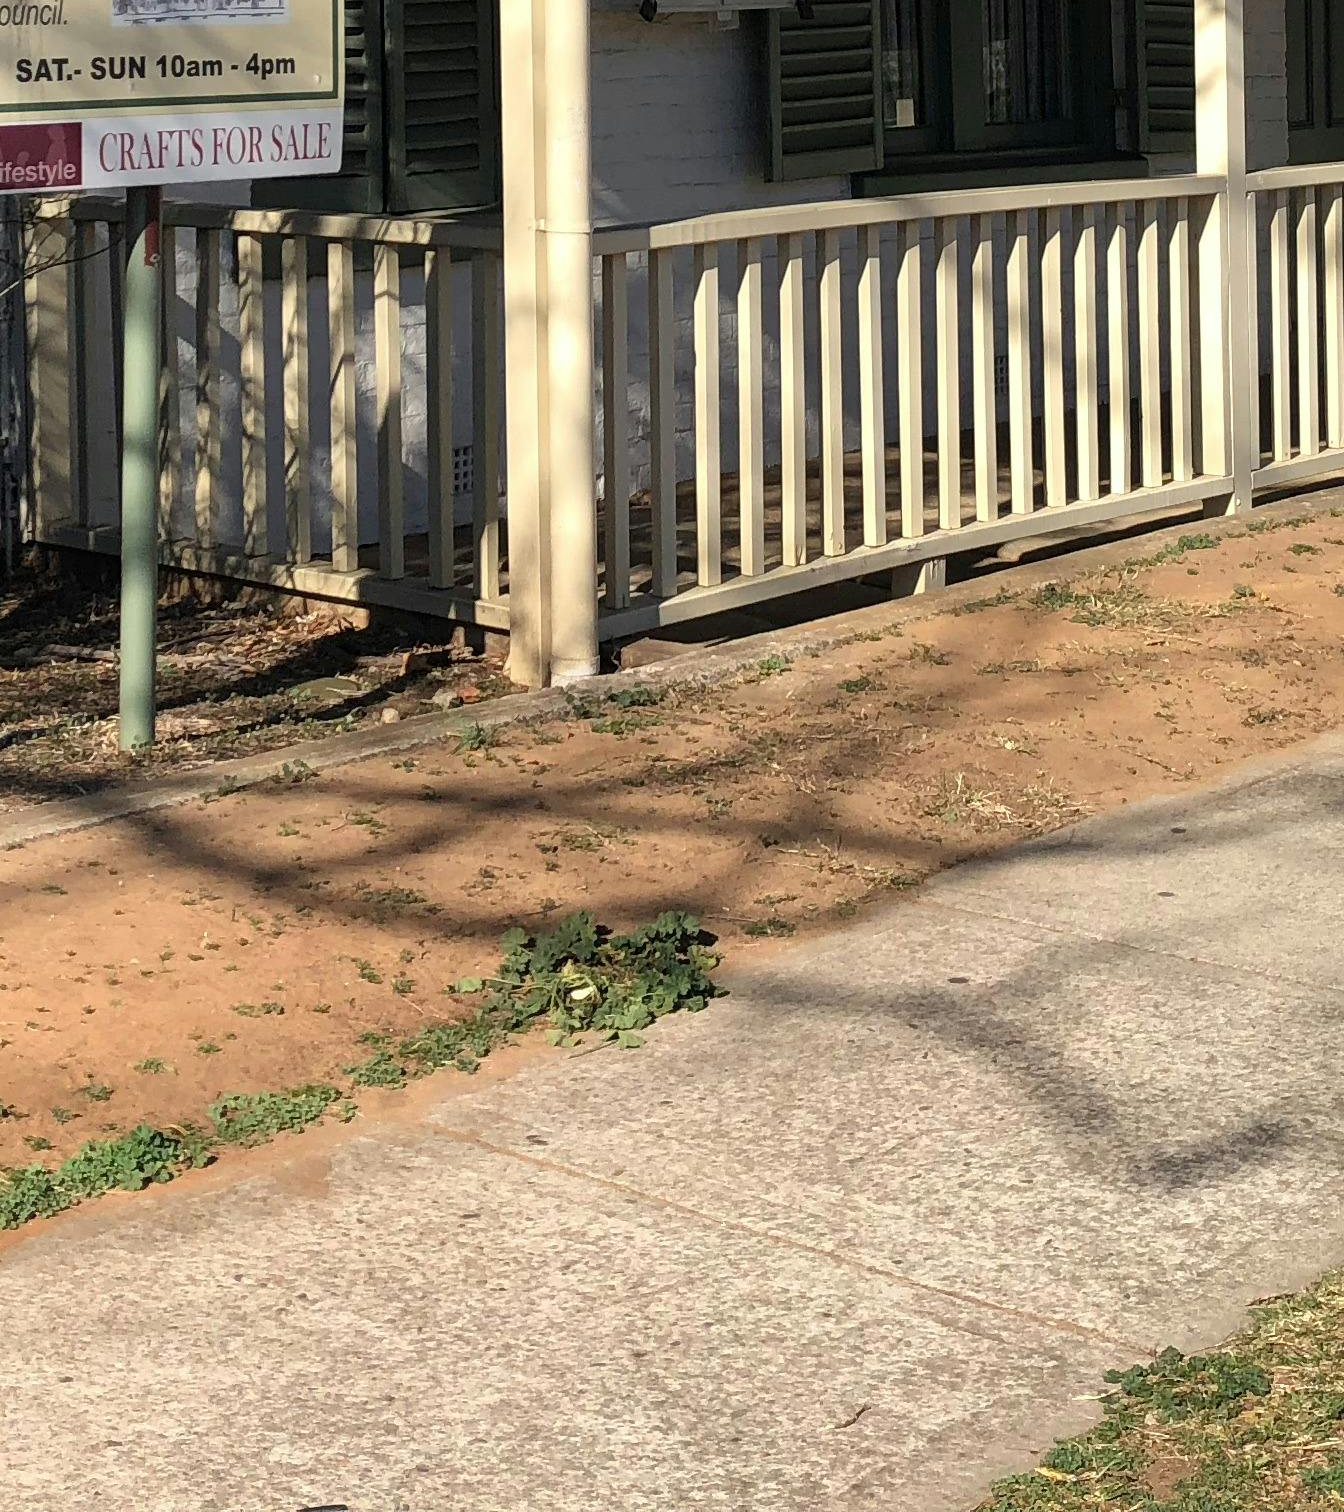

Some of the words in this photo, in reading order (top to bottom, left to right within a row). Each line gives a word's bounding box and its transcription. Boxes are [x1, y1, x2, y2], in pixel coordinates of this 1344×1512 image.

[90, 56, 147, 80] SUN
[156, 54, 223, 79] 10am
[245, 53, 297, 80] 4pm
[98, 127, 205, 172] CRAFTS
[210, 126, 266, 167] FOR
[271, 122, 332, 161] SALE
